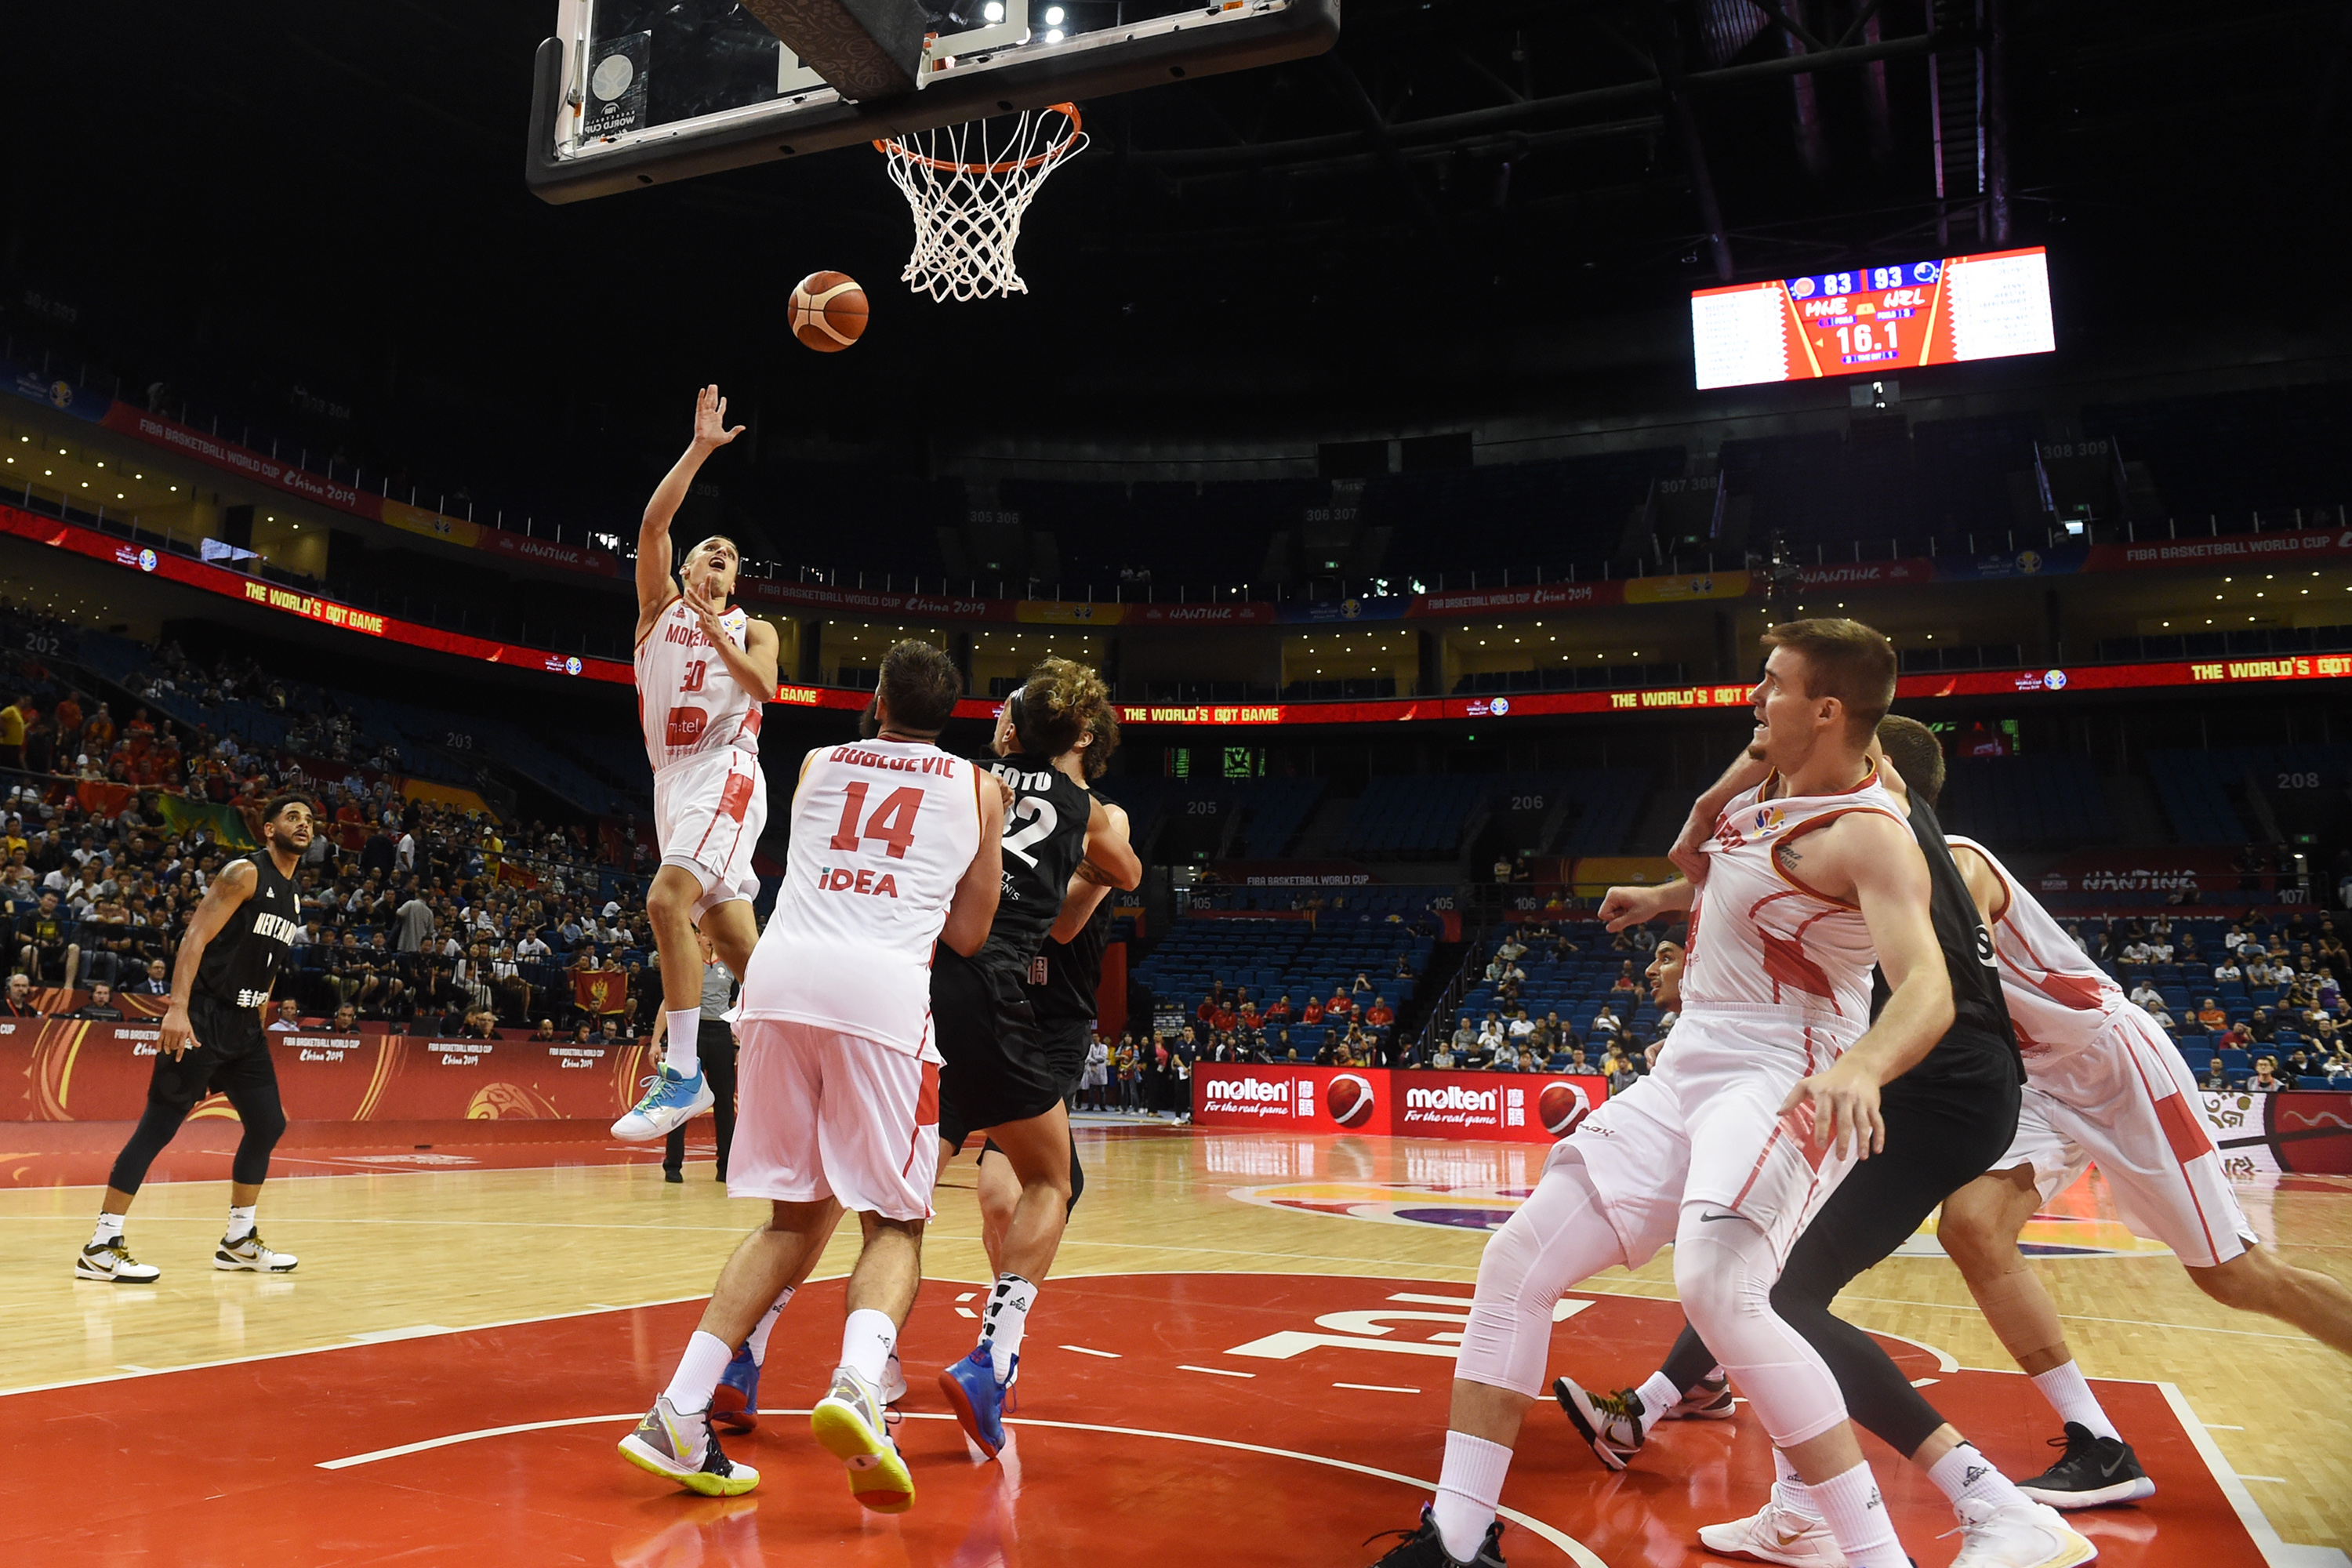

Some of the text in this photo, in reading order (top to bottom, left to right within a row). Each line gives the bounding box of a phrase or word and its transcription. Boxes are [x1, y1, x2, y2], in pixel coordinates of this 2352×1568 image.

[1824, 267, 1902, 296] 83 93
[1805, 288, 1926, 317] MNE NZL
[1836, 321, 1898, 354] 16.1
[140, 418, 280, 478] FIBA BASKETBALL WORLD CUP
[2043, 439, 2108, 459] 308 309
[284, 470, 356, 506] China 2019
[1661, 476, 1718, 494] 307 308
[970, 510, 1020, 525] 305 306
[1306, 508, 1358, 521] 306 307
[2127, 548, 2157, 561] FIBA
[2161, 543, 2248, 559] BASKETBALL
[2249, 538, 2299, 552] WORLD
[2303, 536, 2330, 547] CUP
[758, 583, 901, 608] FIBA BASKETBALL WORLD CUP
[1428, 593, 1530, 609] FIBA BASKETBALL WORLD CUP
[1533, 586, 1592, 604] China 2019
[245, 582, 383, 633] THE WORLD'S GOT GAME
[905, 597, 986, 615] China 2019
[25, 632, 60, 656] 202
[2191, 656, 2352, 680] THE WORLD'S GOT
[781, 688, 817, 702] GAME
[1611, 693, 1637, 708] THE
[1642, 687, 1708, 706] WORLD'S
[1715, 688, 1742, 706] GOT
[1124, 706, 1279, 724] THE WORLD'S GOT GAME
[669, 718, 699, 734] m:tel
[446, 731, 472, 750] 203
[990, 763, 1053, 793] FOTU
[2278, 772, 2321, 789] 208
[1186, 800, 1217, 815] 205
[1511, 794, 1544, 811] 206
[829, 781, 925, 860] 14
[1247, 874, 1370, 886] FIBA BASKETBALL WORLD CUP
[1120, 895, 1140, 907] 104
[1191, 896, 1454, 909] 105 105
[1515, 896, 1537, 910] 106
[2278, 889, 2305, 905] 107
[0, 1024, 16, 1035] CUP
[114, 1029, 130, 1040] FIBA
[283, 1036, 361, 1049] FIBA BASKETBALL WORLD CUP
[428, 1043, 439, 1052] FIBA
[439, 1043, 467, 1053] BASKETBALL
[483, 1044, 493, 1054] CUP
[299, 1048, 344, 1062] China 2019
[441, 1054, 479, 1066] China 2019
[549, 1047, 559, 1056] FIBA
[559, 1047, 583, 1057] BASKETBALL
[561, 1058, 593, 1069] China 2019
[1207, 1078, 1288, 1102] molten
[1406, 1086, 1496, 1111] molten
[1203, 1101, 1289, 1117] For the real game
[1404, 1109, 1497, 1127] For the real game
